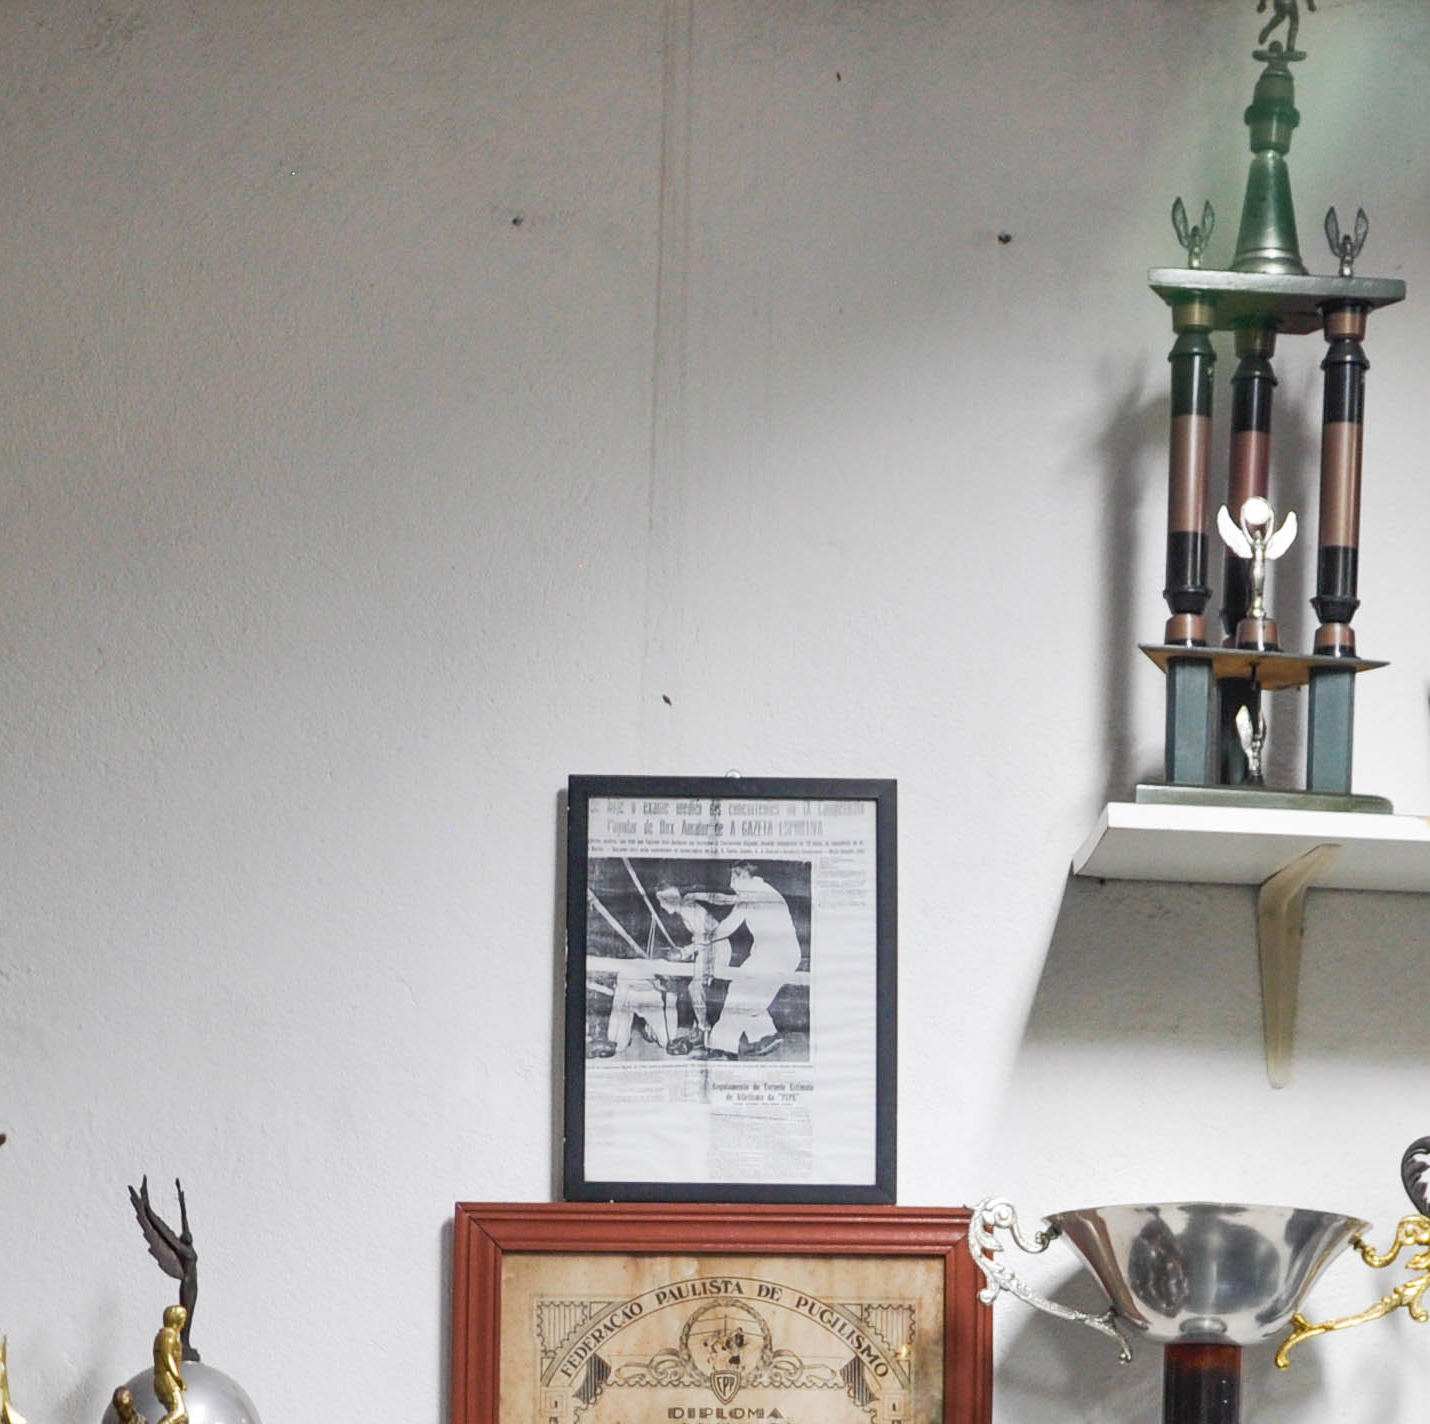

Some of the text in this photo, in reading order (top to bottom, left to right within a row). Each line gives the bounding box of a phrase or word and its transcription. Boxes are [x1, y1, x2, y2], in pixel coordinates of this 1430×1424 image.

[654, 1278, 745, 1307] PAULISTA
[756, 1283, 784, 1303] DE
[794, 1296, 890, 1380] PUGILISMO
[667, 1407, 784, 1420] DIPLOMA
